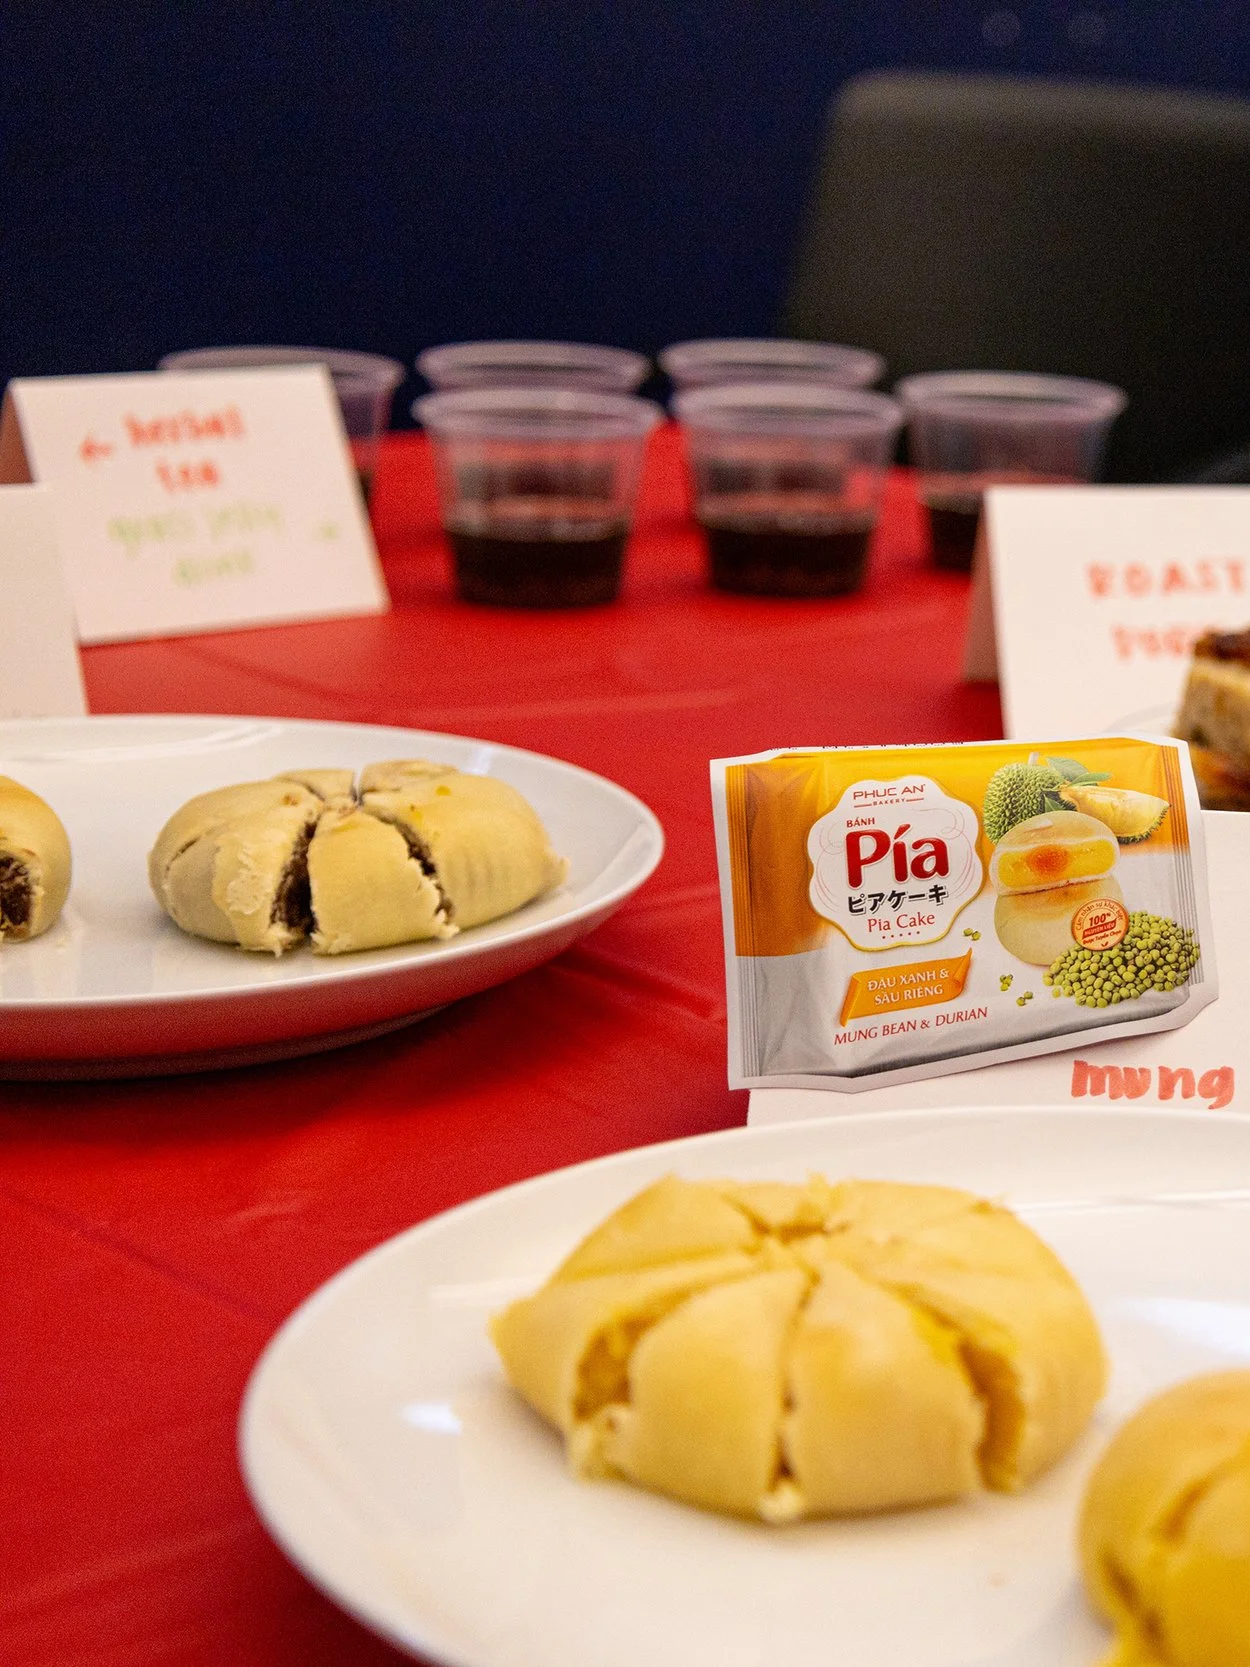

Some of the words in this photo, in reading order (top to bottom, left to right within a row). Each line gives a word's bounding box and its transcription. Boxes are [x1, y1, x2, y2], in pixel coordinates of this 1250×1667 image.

[1086, 557, 1247, 599] ROAST
[901, 785, 924, 795] AN
[873, 798, 906, 806] BAKERY
[846, 817, 875, 828] BÁNH
[845, 823, 949, 889] Pía
[848, 884, 948, 914] ピアケーキ
[868, 918, 891, 932] Pia
[896, 912, 935, 929] Cake
[899, 970, 937, 986] XANH
[939, 968, 950, 979] &
[903, 984, 944, 1001] RIÊNG
[834, 1026, 878, 1045] MUNG
[882, 1020, 917, 1037] BEAN
[920, 1019, 930, 1029] &
[935, 1007, 988, 1026] DURIAN
[1071, 1059, 1235, 1110] mung
